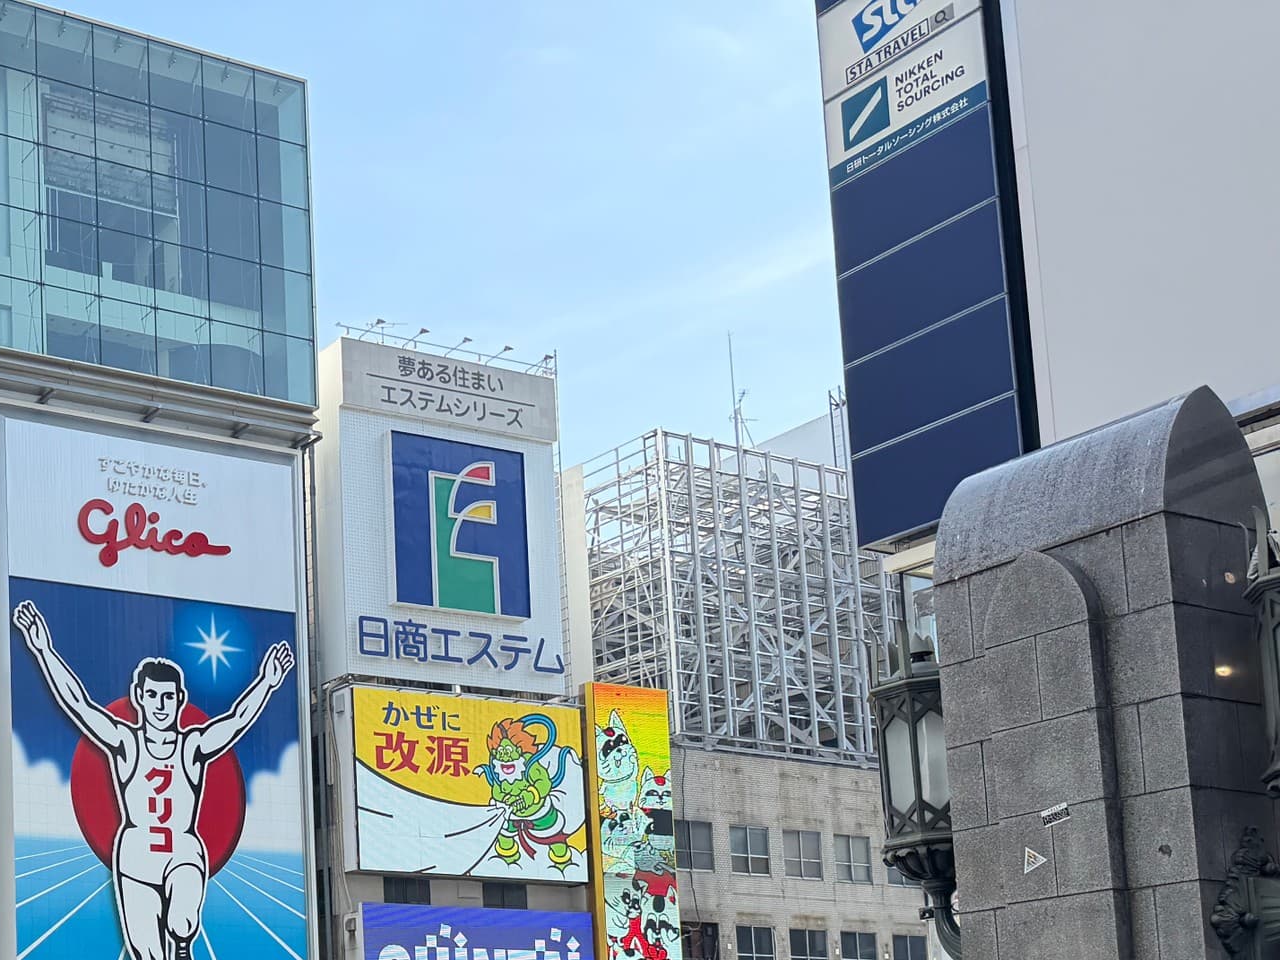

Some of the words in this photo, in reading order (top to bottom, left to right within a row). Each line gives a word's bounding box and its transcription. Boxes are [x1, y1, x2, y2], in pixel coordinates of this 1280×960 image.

[849, 57, 873, 81] STA
[875, 22, 928, 63] TRAVEL
[895, 50, 944, 87] NIKKEN
[896, 69, 938, 99] TOTAL
[897, 65, 966, 112] SOURCING
[846, 97, 969, 174] 日研トータルソーシング株式会社
[397, 355, 504, 393] 夢ある住まい
[381, 384, 523, 428] エステムシリーズ
[77, 498, 231, 567] Glico
[358, 615, 565, 675] 日商エステム
[382, 702, 460, 731] かぜに
[373, 731, 471, 777] 改源
[144, 764, 174, 854] グリコ
